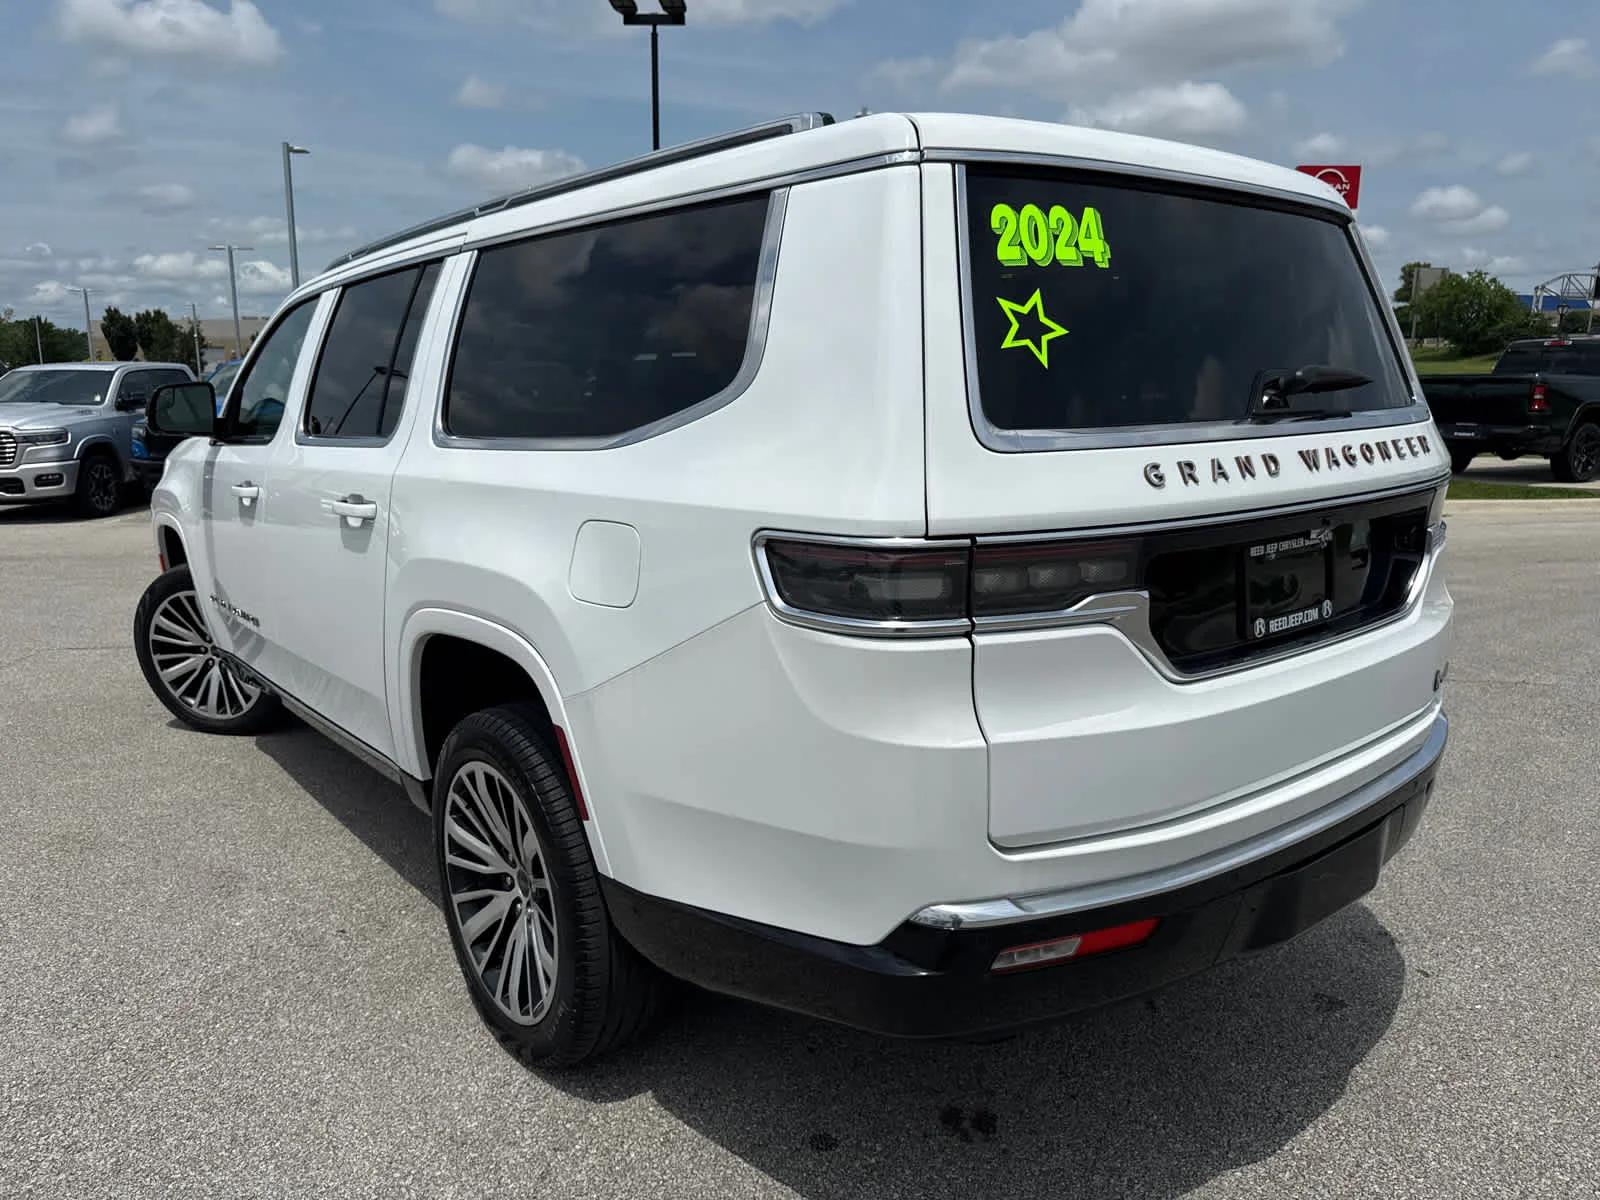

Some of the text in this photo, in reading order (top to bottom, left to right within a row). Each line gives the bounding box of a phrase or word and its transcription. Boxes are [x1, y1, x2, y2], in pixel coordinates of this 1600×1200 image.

[990, 203, 1111, 269] 2024
[1144, 434, 1431, 489] GRAND WAGONEER
[1269, 607, 1319, 634] REEDJEEP.COM
